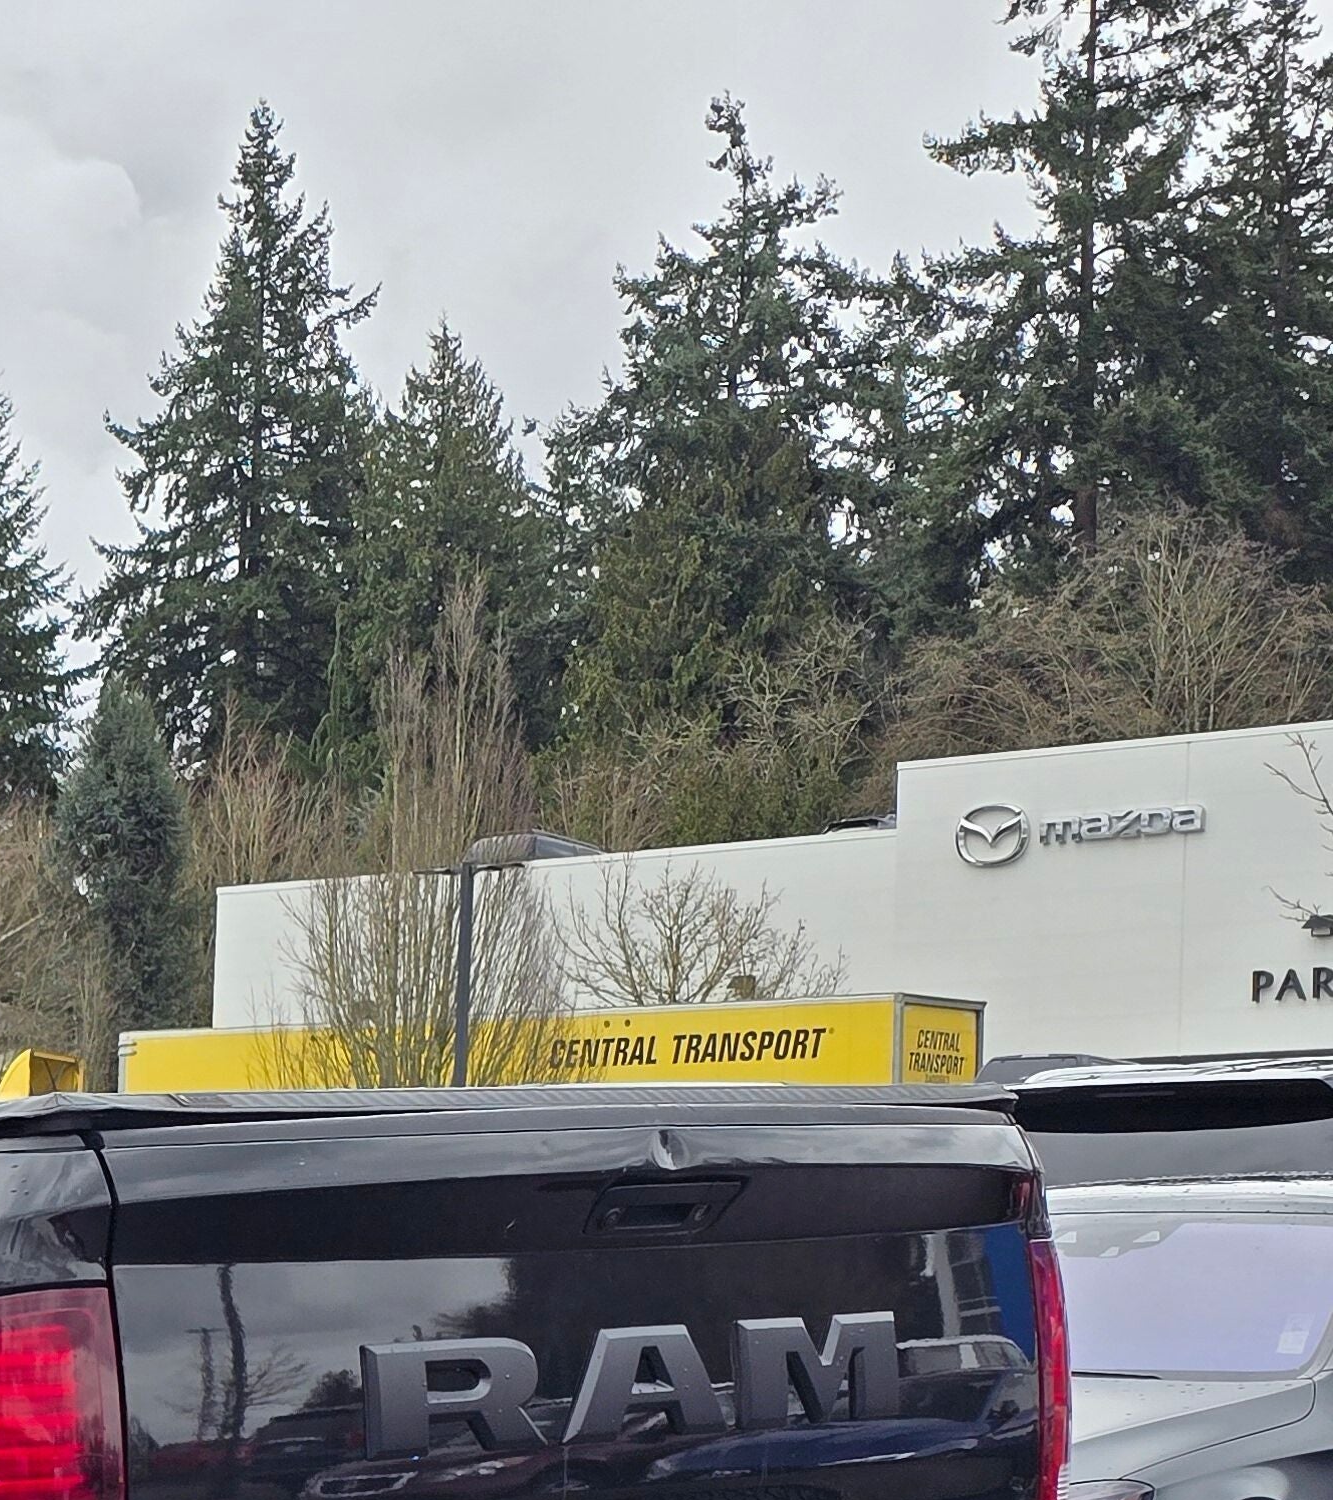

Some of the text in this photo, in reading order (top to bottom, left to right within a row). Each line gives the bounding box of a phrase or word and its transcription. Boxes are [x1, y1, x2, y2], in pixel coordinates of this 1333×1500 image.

[1039, 805, 1206, 845] mazda
[549, 1028, 826, 1069] CENTRAL TRANSPORT
[917, 1029, 960, 1053] CENTRAL
[908, 1052, 964, 1076] TRANSPORT
[360, 1311, 900, 1460] RAM
